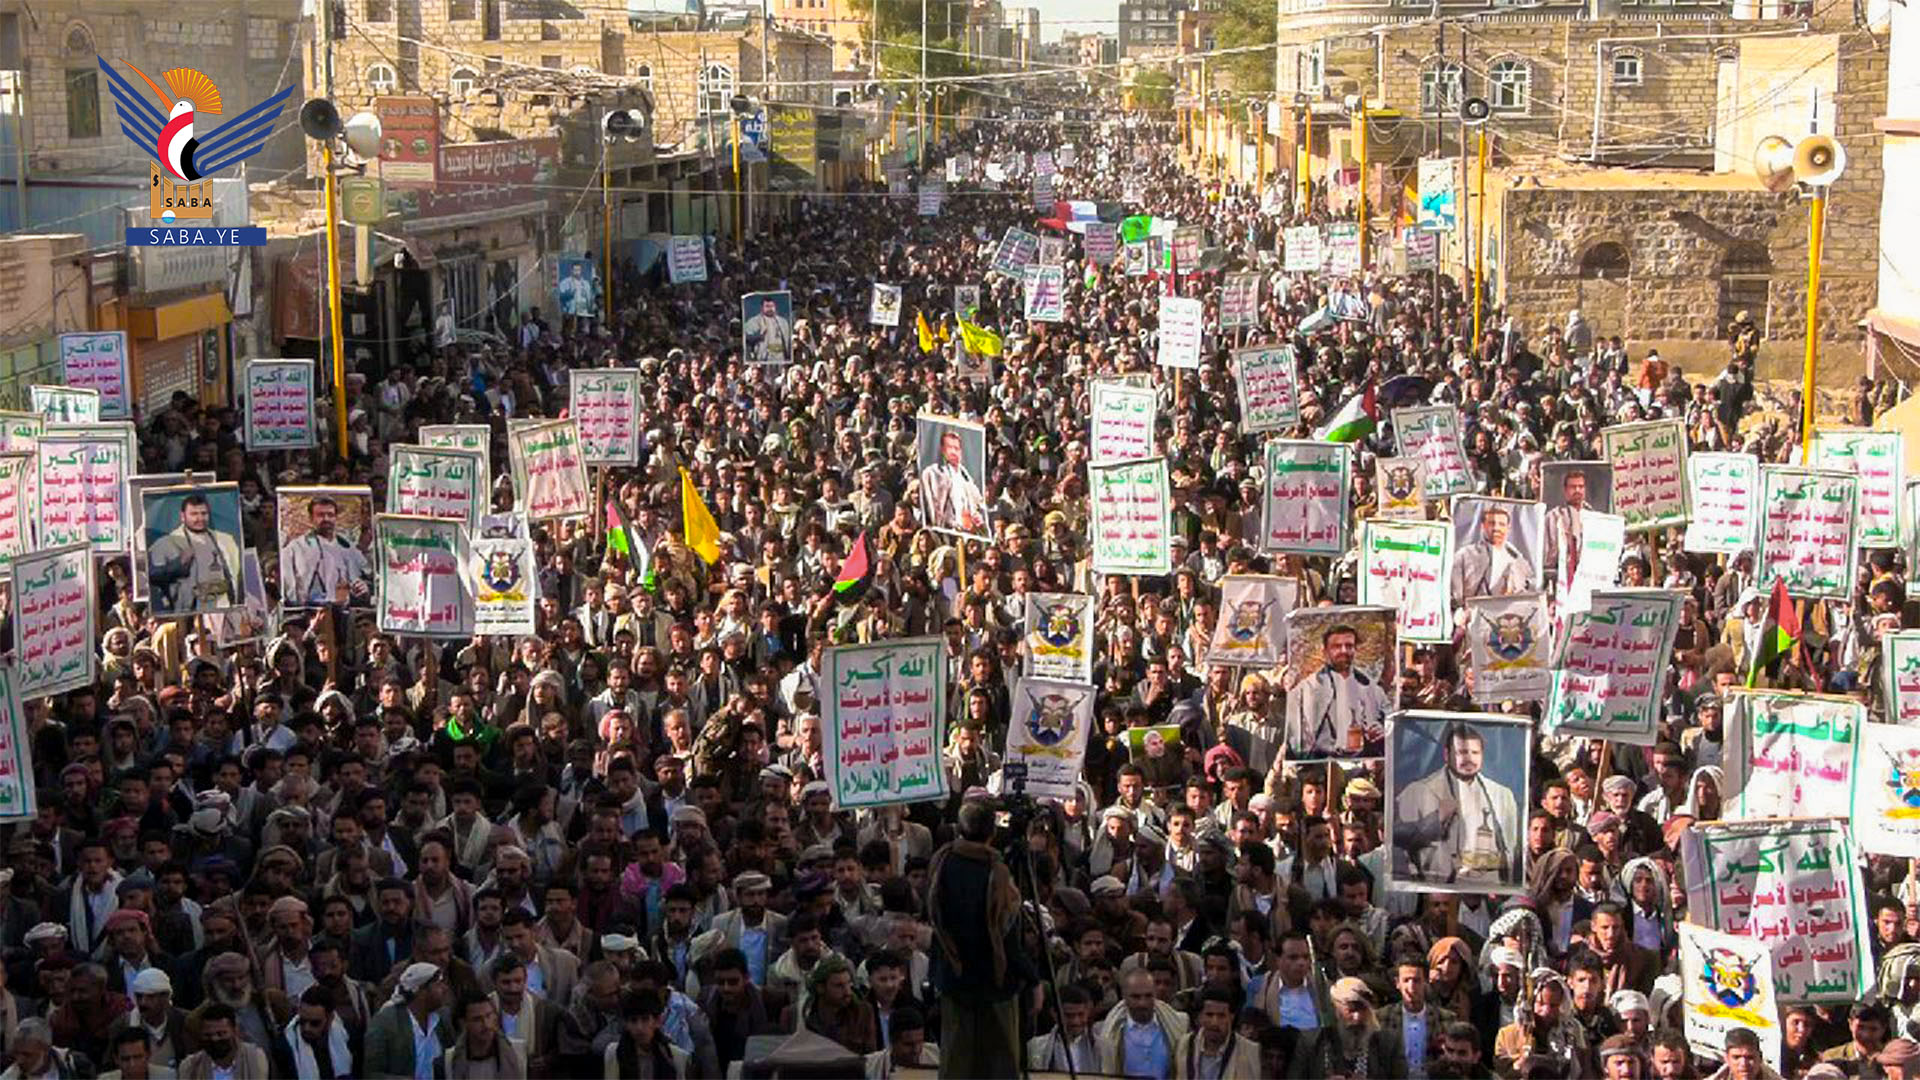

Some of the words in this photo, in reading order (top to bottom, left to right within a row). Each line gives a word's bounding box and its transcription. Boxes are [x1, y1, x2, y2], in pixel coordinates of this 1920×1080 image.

[1631, 606, 1668, 628] الله
[1570, 627, 1619, 649] لأمريكا
[1621, 635, 1660, 653] الموت
[839, 651, 897, 689] أكبر
[899, 652, 933, 678] الله
[1563, 650, 1616, 674] لإسرائيل
[1616, 660, 1656, 677] الموت
[839, 683, 891, 711] لأمريكا
[894, 686, 933, 707] الموت
[1560, 675, 1595, 697] اليهود
[1597, 686, 1618, 699] على
[1621, 680, 1652, 698] اللعنة
[895, 711, 933, 734] الموت
[1605, 701, 1648, 727] النصر
[841, 714, 891, 741] لإسرائيل
[841, 744, 876, 768] اليهود
[880, 744, 900, 765] على
[903, 736, 933, 757] اللعنة
[840, 767, 890, 801] للإسلام
[893, 762, 936, 795] النصر
[1717, 838, 1790, 885] أكبر
[1796, 841, 1843, 871] الله
[1719, 881, 1787, 909] لأمريكا
[1791, 880, 1846, 907] الموت
[1794, 911, 1850, 939] الموت
[1779, 946, 1805, 969] على
[1810, 942, 1854, 964] اللعنة
[1802, 967, 1858, 1000] النصر
